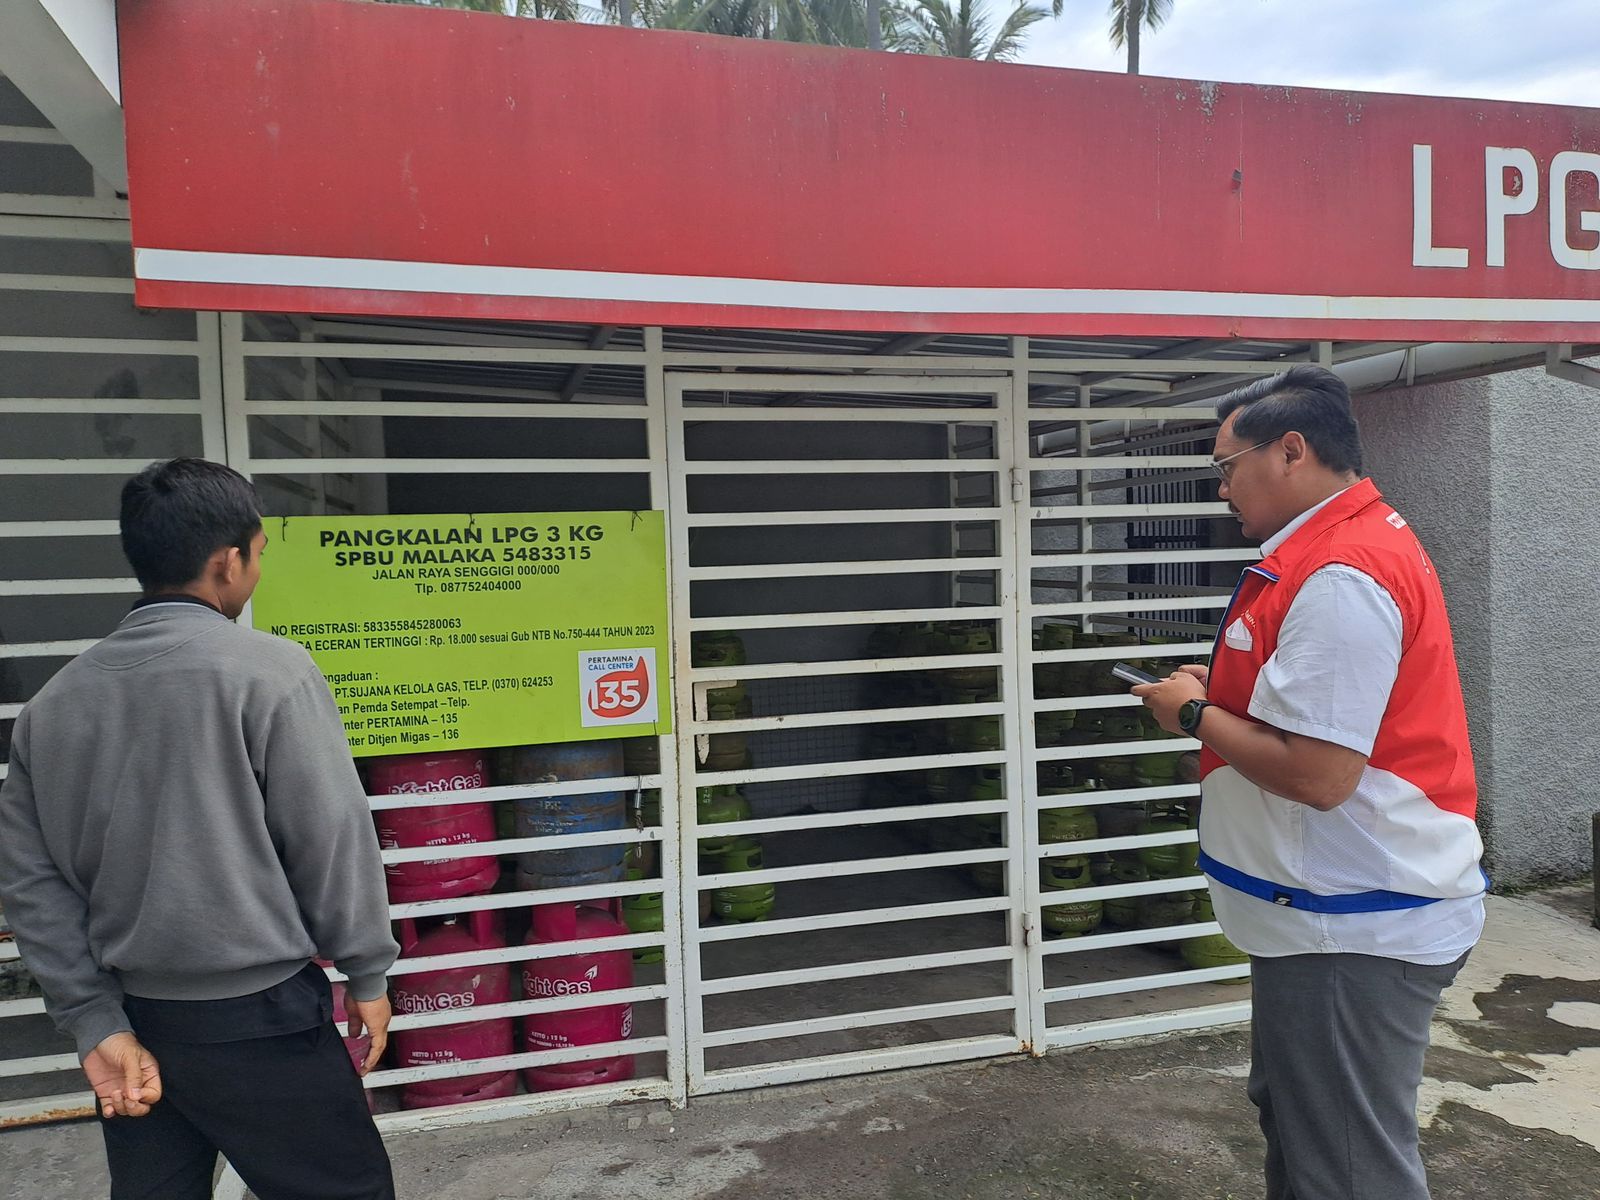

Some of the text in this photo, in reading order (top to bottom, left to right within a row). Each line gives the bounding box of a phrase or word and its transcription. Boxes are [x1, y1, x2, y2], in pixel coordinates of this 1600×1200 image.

[1413, 144, 1600, 270] LPG
[320, 525, 604, 547] PANGKALAN LPG 3 KG
[335, 546, 591, 566] SPBU MALAKA 5483315
[372, 564, 560, 580] JALAN RAYA SENGGIGI 000/000
[415, 580, 521, 595] Tlp. 087752404000
[271, 618, 461, 636] NO REGISTRASI: 583355845280063
[315, 638, 361, 651] ECERAN
[364, 636, 422, 649] TERTINGGI
[429, 635, 446, 648] Rp.
[449, 633, 477, 645] 18.000
[479, 632, 509, 643] sesuai
[511, 630, 530, 642] Gub
[532, 629, 551, 641] NTB
[553, 627, 601, 640] No.750-444
[602, 626, 634, 638] TAHUN
[635, 625, 655, 636] 2023
[587, 655, 634, 664] PERTAMINA
[607, 662, 634, 670] CENTER
[323, 671, 373, 685] ngaduan
[334, 676, 554, 699] PT.SUJANA KELOLA GAS, TELP. (0370) 624253
[591, 679, 641, 710] 135
[353, 702, 388, 714] Pemda
[391, 698, 438, 712] Setempat
[343, 720, 365, 731] nter
[367, 715, 429, 729] PERTAMINA
[440, 713, 458, 724] 135
[368, 733, 398, 747] Ditjen
[400, 730, 430, 745] Migas
[442, 729, 459, 740] 136
[450, 773, 482, 792] Gas
[553, 979, 591, 996] Gas
[434, 992, 475, 1010] Gas
